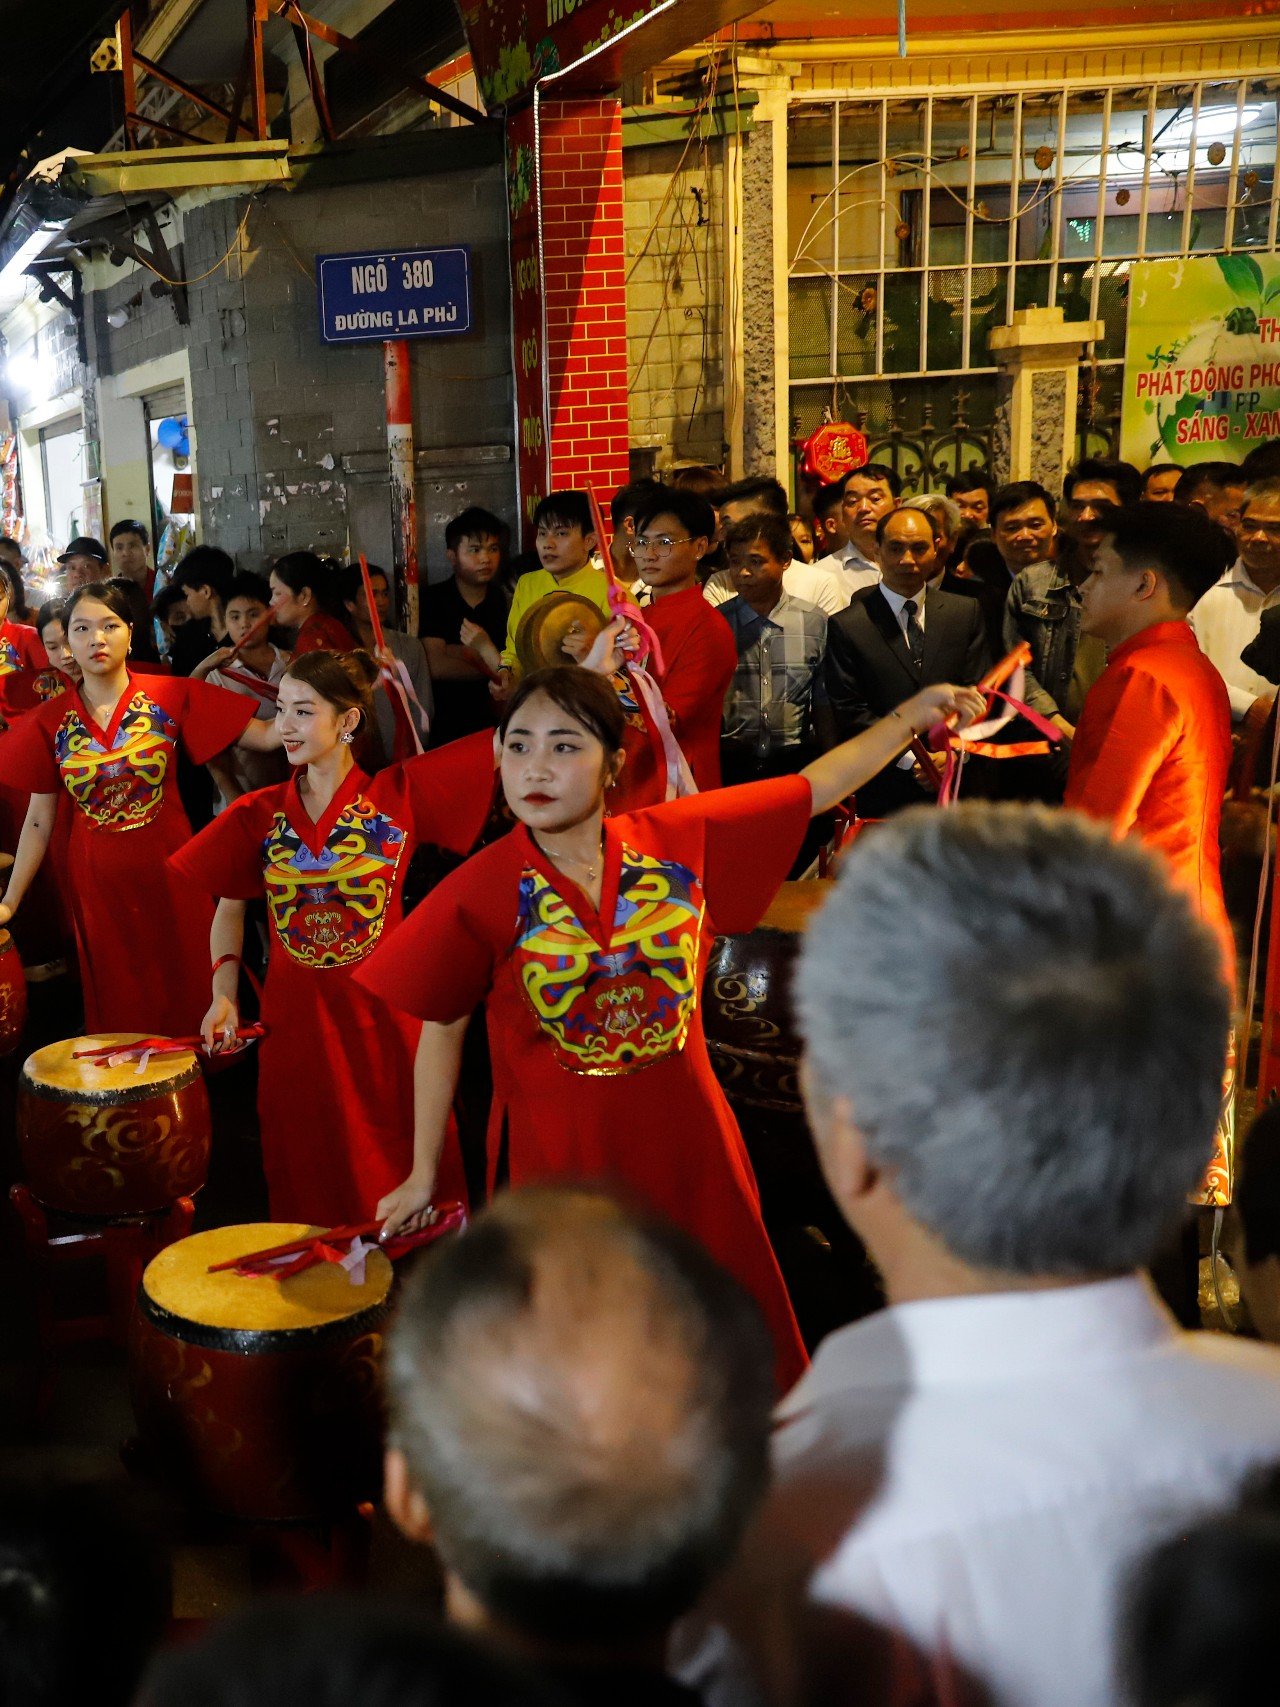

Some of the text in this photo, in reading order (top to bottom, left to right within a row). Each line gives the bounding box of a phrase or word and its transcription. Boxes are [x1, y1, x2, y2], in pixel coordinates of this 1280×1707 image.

[352, 258, 434, 294] NGÕ 380
[335, 308, 393, 332] ĐƯỜNG
[398, 308, 419, 326] LA
[1136, 363, 1187, 398] PHÁT
[1190, 361, 1245, 400] ĐỘNG
[1177, 410, 1230, 444] SÁNG
